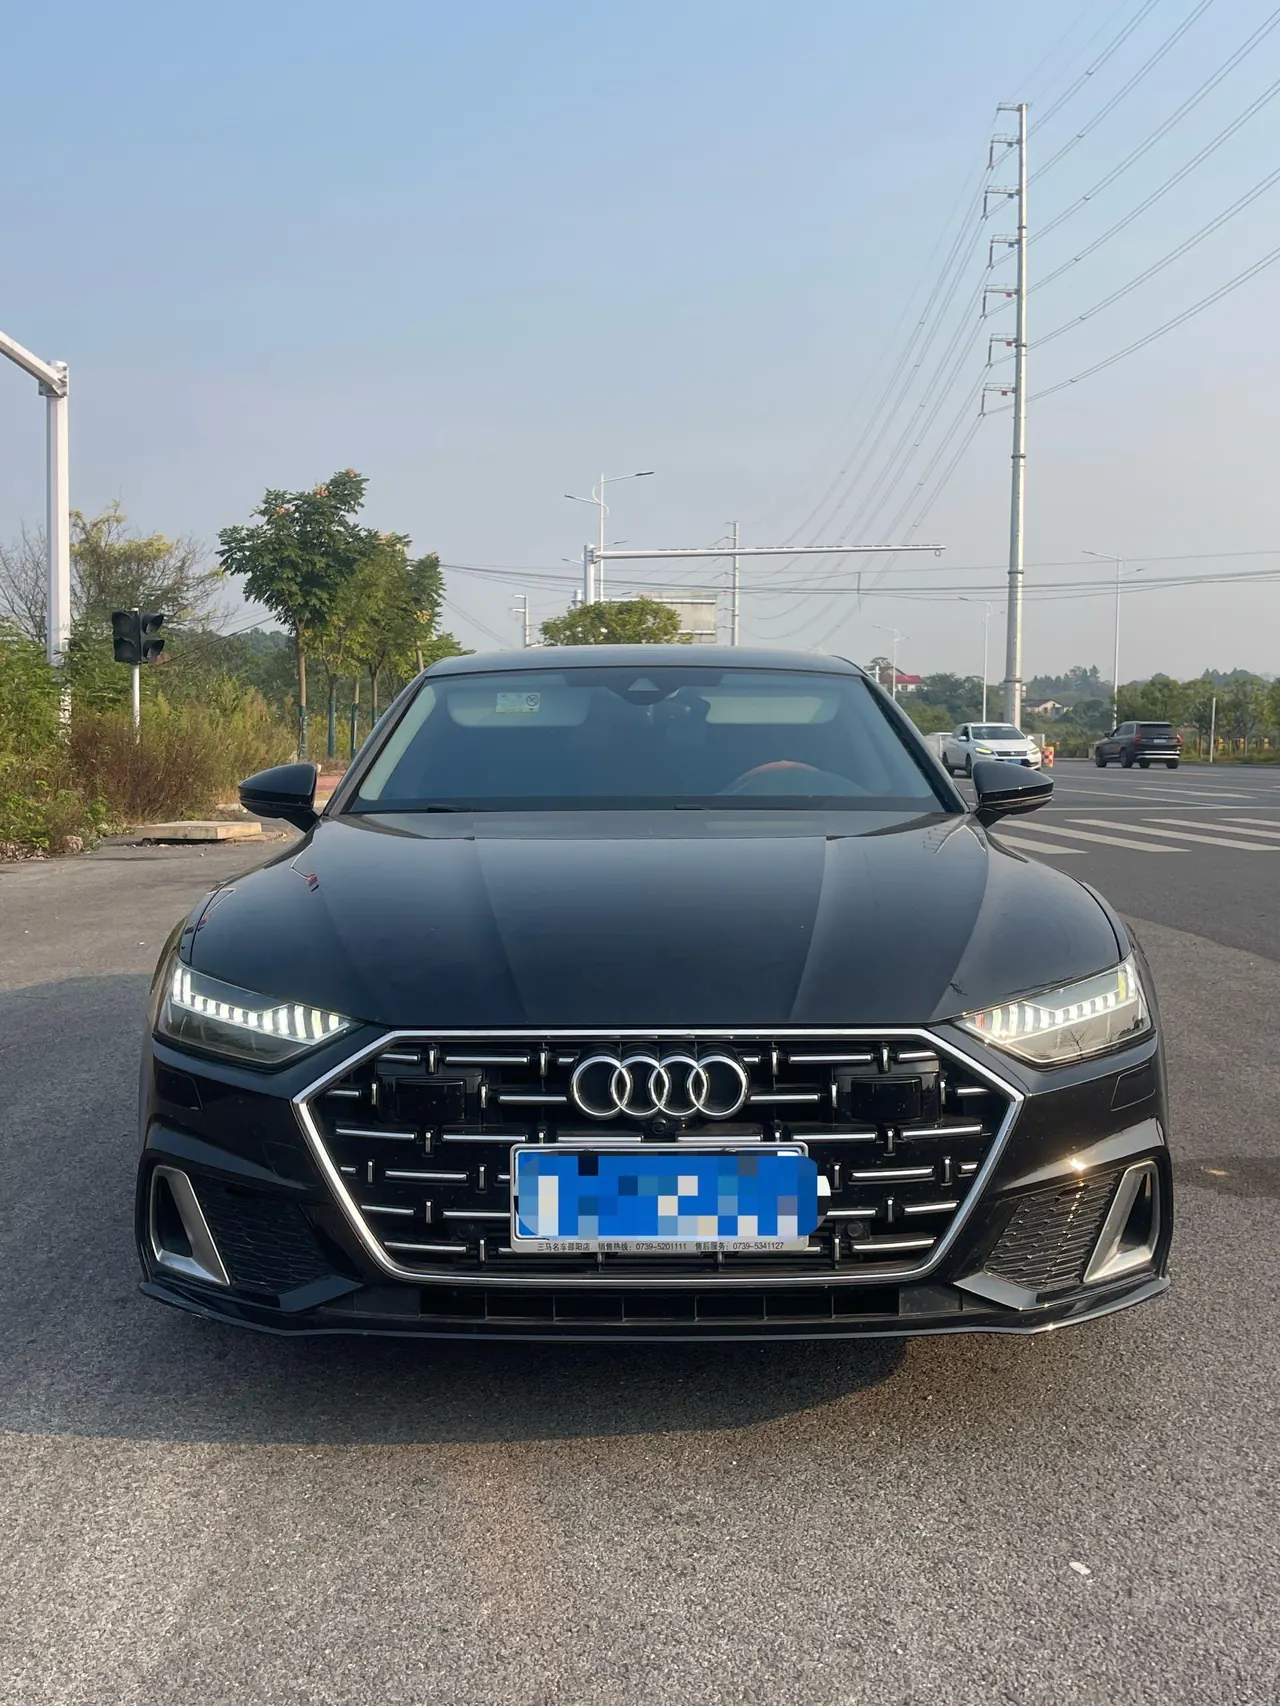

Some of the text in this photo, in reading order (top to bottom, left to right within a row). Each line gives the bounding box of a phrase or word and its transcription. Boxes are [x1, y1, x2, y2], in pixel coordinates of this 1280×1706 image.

[537, 1242, 590, 1251] 三马名车邵阳店
